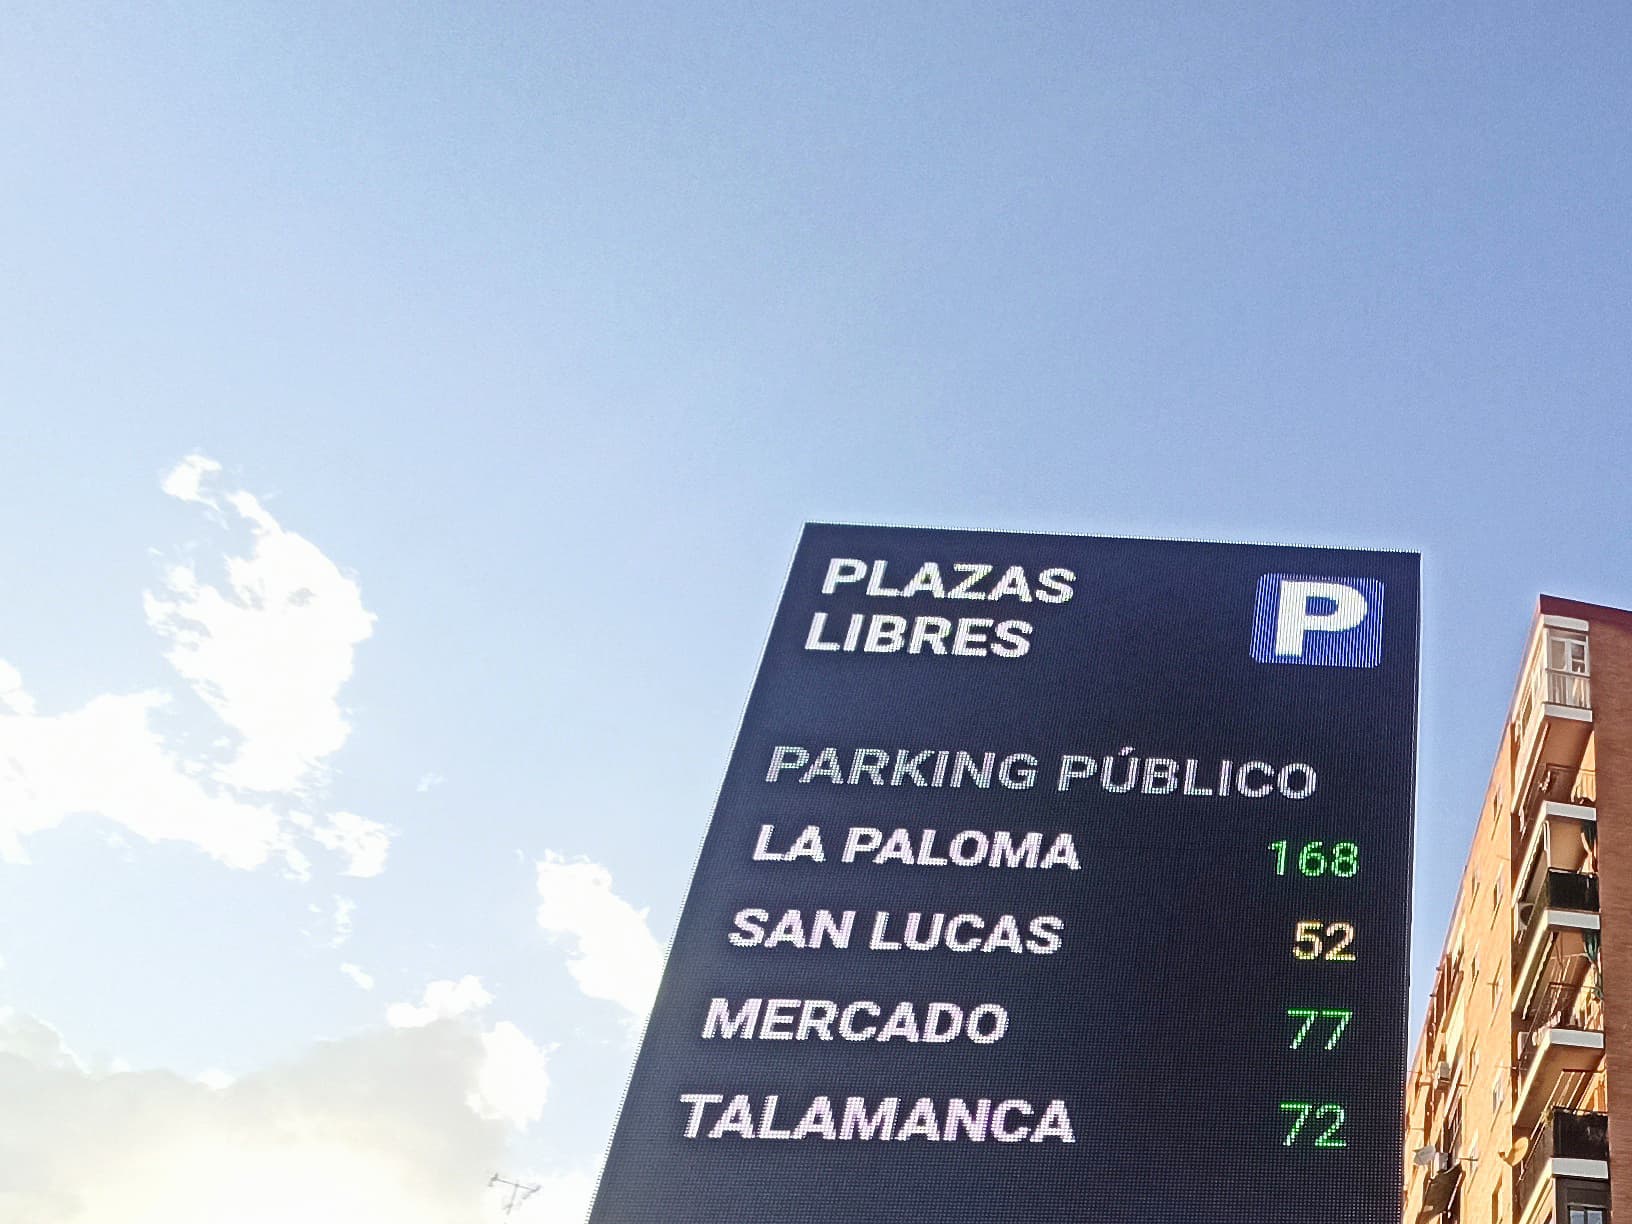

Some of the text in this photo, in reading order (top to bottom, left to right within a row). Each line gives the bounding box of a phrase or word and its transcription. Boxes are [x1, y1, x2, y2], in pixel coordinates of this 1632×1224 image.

[822, 558, 1076, 603] PLAZAS
[805, 612, 1032, 657] LIBRES
[1274, 580, 1369, 658] P
[766, 746, 1316, 798] PARKING PÚBLICO
[753, 825, 1359, 877] LA PALOMA 168
[728, 908, 1355, 960] SAN LUCAS 52
[702, 998, 1352, 1050] MERCADO 77
[680, 1094, 1346, 1146] TALAMANCA 72
